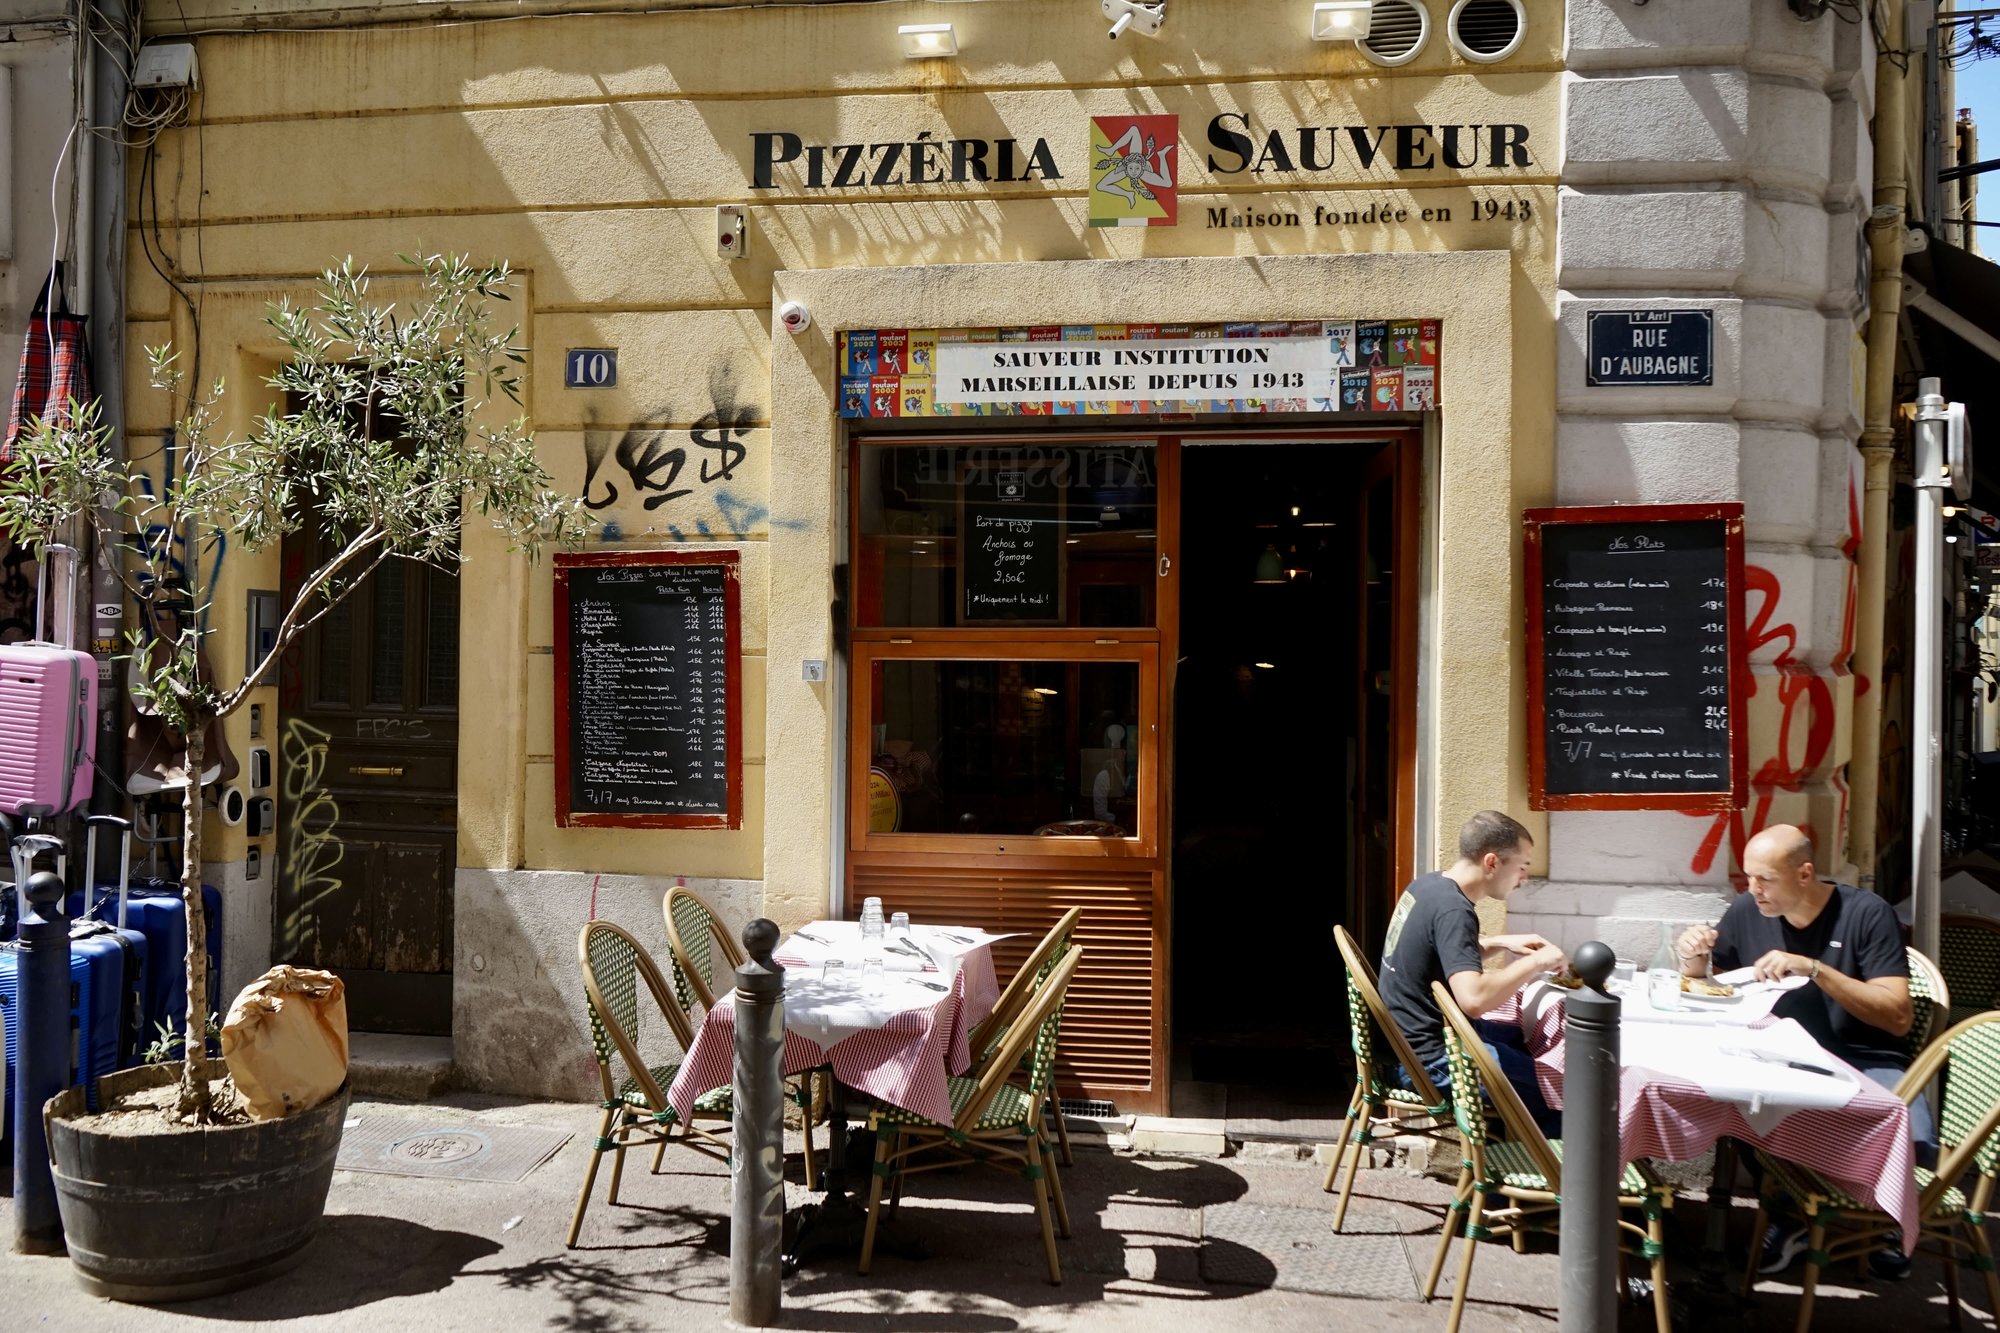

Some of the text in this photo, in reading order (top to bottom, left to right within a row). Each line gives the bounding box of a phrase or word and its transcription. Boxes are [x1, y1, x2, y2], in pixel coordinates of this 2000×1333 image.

[748, 113, 1533, 189] PIZZÉRIA SAUVEUR
[1207, 200, 1533, 228] Maison fondée en 1943
[1393, 327, 1418, 335] 2019
[1633, 329, 1668, 347] RUE
[993, 348, 1269, 368] SAUVEUR INSTITUTION
[574, 354, 609, 384] 10
[1601, 356, 1699, 375] D'AUBAGNE
[960, 372, 1304, 393] MARSEILLAISE DEPUIS 1943
[1407, 379, 1433, 387] 2022
[995, 517, 1004, 527] de
[1009, 519, 1033, 533] pizza
[982, 535, 1034, 551] Anchois ou
[1634, 535, 1665, 549] Plats
[994, 551, 1033, 566] fromage
[597, 570, 615, 581] Nos
[994, 570, 1025, 584] 2,50€
[1701, 578, 1726, 588] 17€
[1020, 593, 1028, 603] le
[1700, 601, 1724, 610] 18€
[1700, 623, 1725, 632] 19€
[1700, 645, 1724, 653] 16€
[1701, 666, 1724, 675] 21€
[1698, 686, 1724, 695] 15€
[689, 696, 704, 704] 15€
